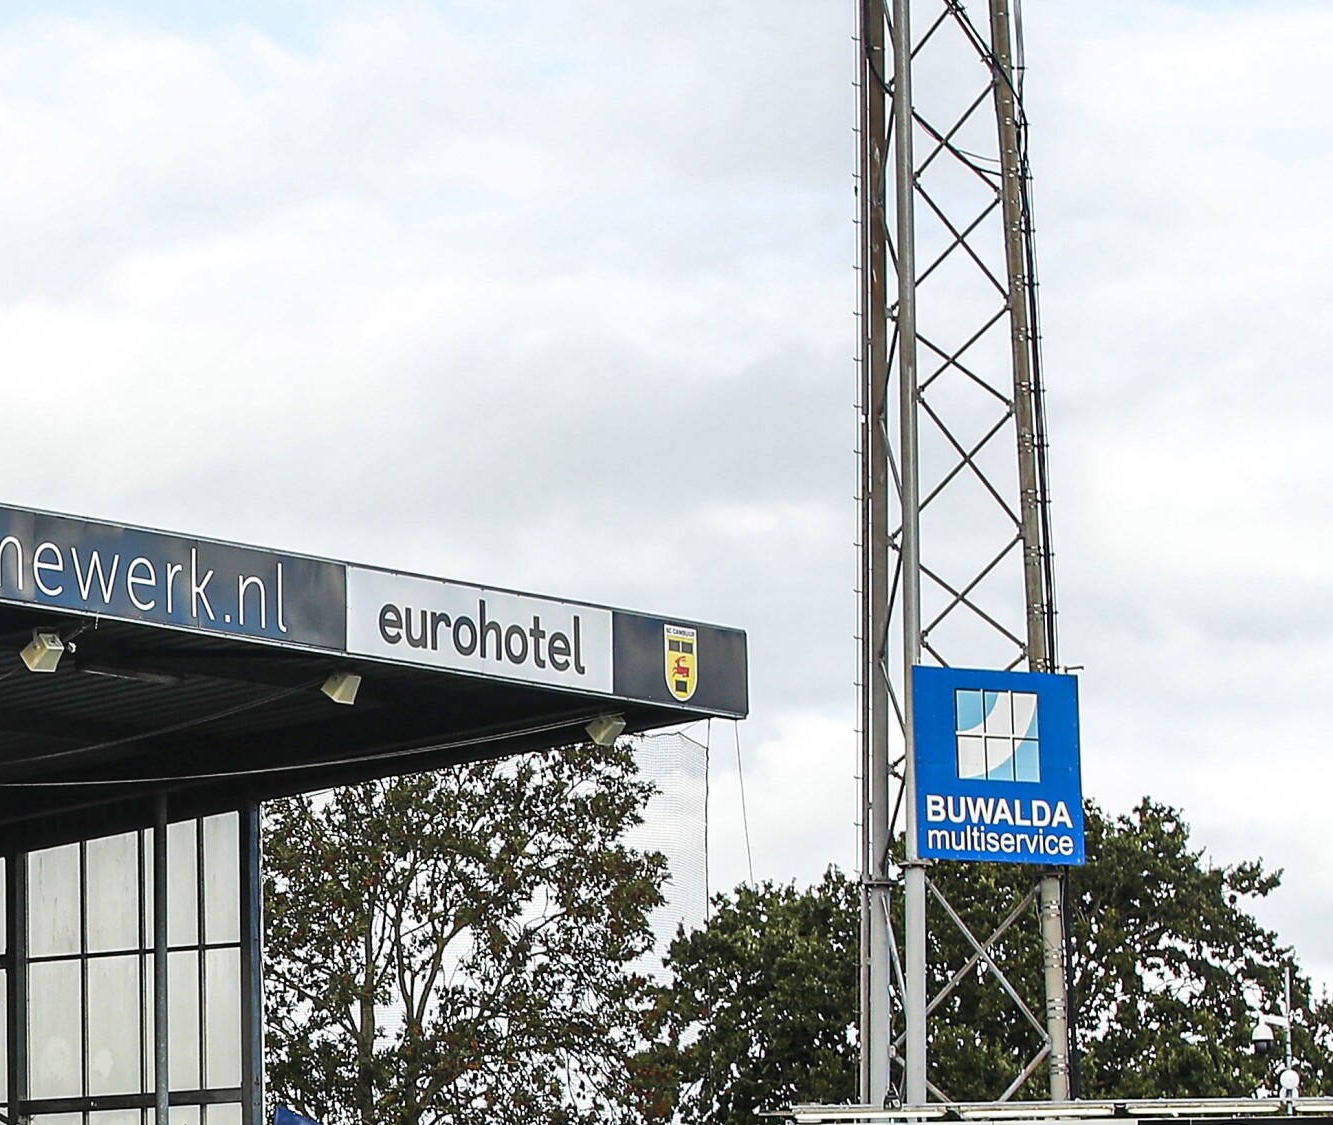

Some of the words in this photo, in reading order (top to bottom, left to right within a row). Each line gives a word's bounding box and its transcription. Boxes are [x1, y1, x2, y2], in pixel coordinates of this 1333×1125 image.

[378, 599, 586, 675] eurohotel
[926, 794, 1074, 829] BUWALDA
[927, 824, 1075, 856] multiservice
